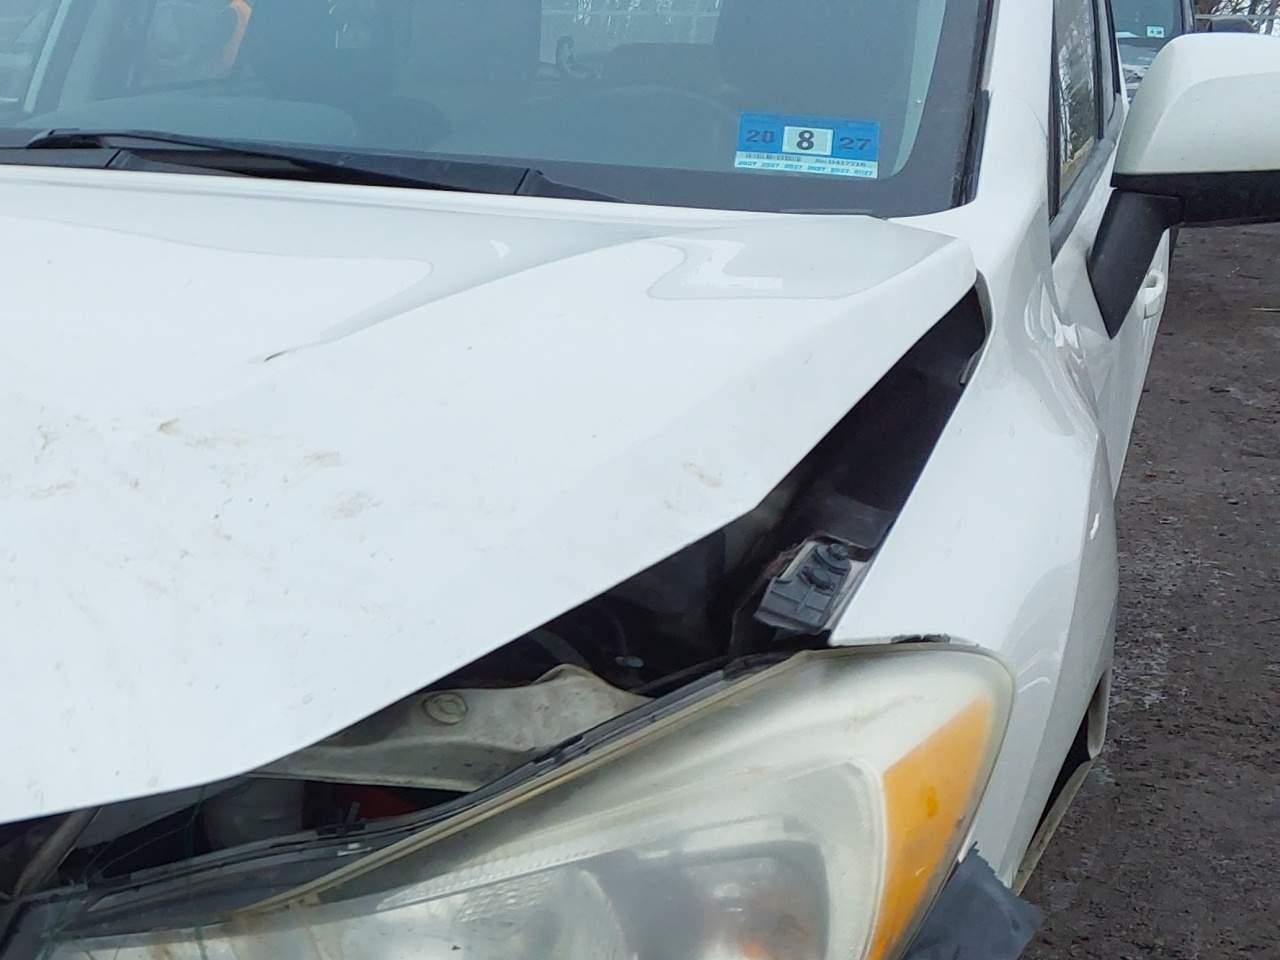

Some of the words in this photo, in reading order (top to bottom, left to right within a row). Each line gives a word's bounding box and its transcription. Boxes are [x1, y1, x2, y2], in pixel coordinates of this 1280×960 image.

[745, 129, 776, 144] 20
[796, 130, 815, 150] 8
[839, 137, 873, 150] 27
